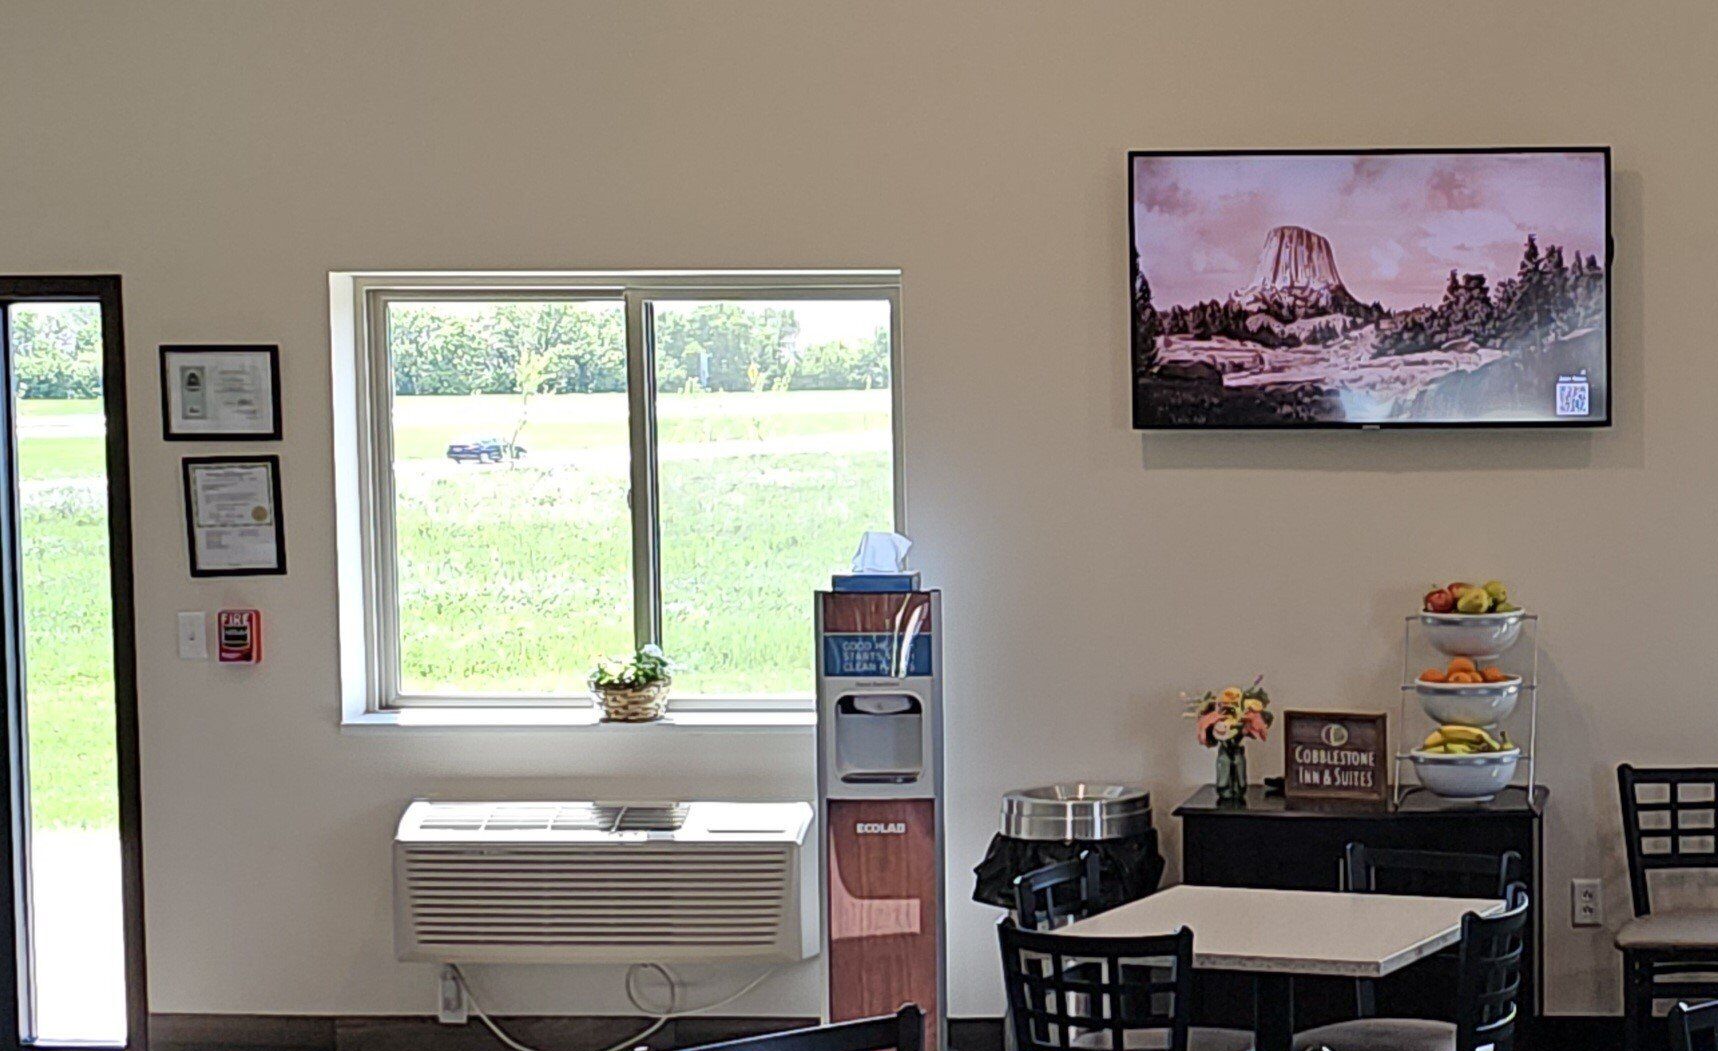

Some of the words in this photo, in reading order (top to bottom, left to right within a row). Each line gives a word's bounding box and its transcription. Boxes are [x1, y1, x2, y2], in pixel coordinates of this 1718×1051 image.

[221, 612, 250, 626] FIRE
[842, 662, 877, 672] CLEAN
[1294, 745, 1375, 767] COBBLESTONE
[1299, 766, 1321, 784] INN
[1323, 769, 1332, 786] &
[1334, 767, 1373, 788] SUITES
[856, 822, 906, 834] ECOLAB
